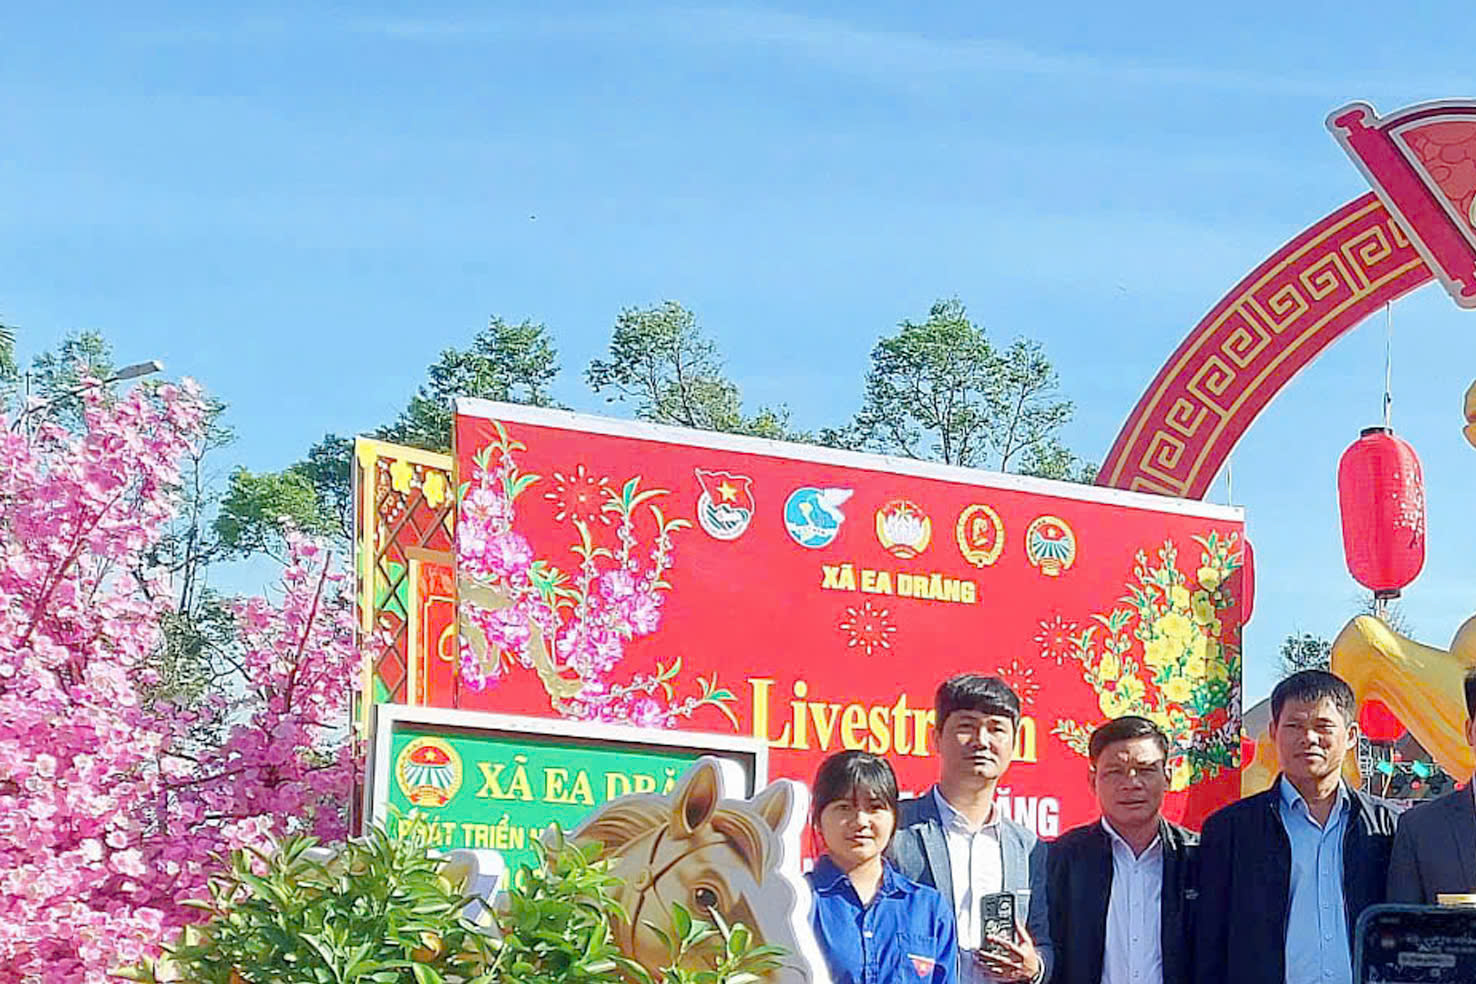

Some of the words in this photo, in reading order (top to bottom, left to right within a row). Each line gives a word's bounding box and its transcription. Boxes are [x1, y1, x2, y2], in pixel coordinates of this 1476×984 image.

[821, 563, 856, 592] XÃ
[861, 569, 893, 595] EA
[896, 569, 977, 604] DRĂNG
[747, 677, 1038, 763] Livestr
[475, 753, 534, 802] XÃ
[543, 767, 595, 806] EA
[604, 767, 676, 801] DRĂ
[461, 813, 525, 849] TRIỂN
[996, 787, 1059, 838] ĂNG
